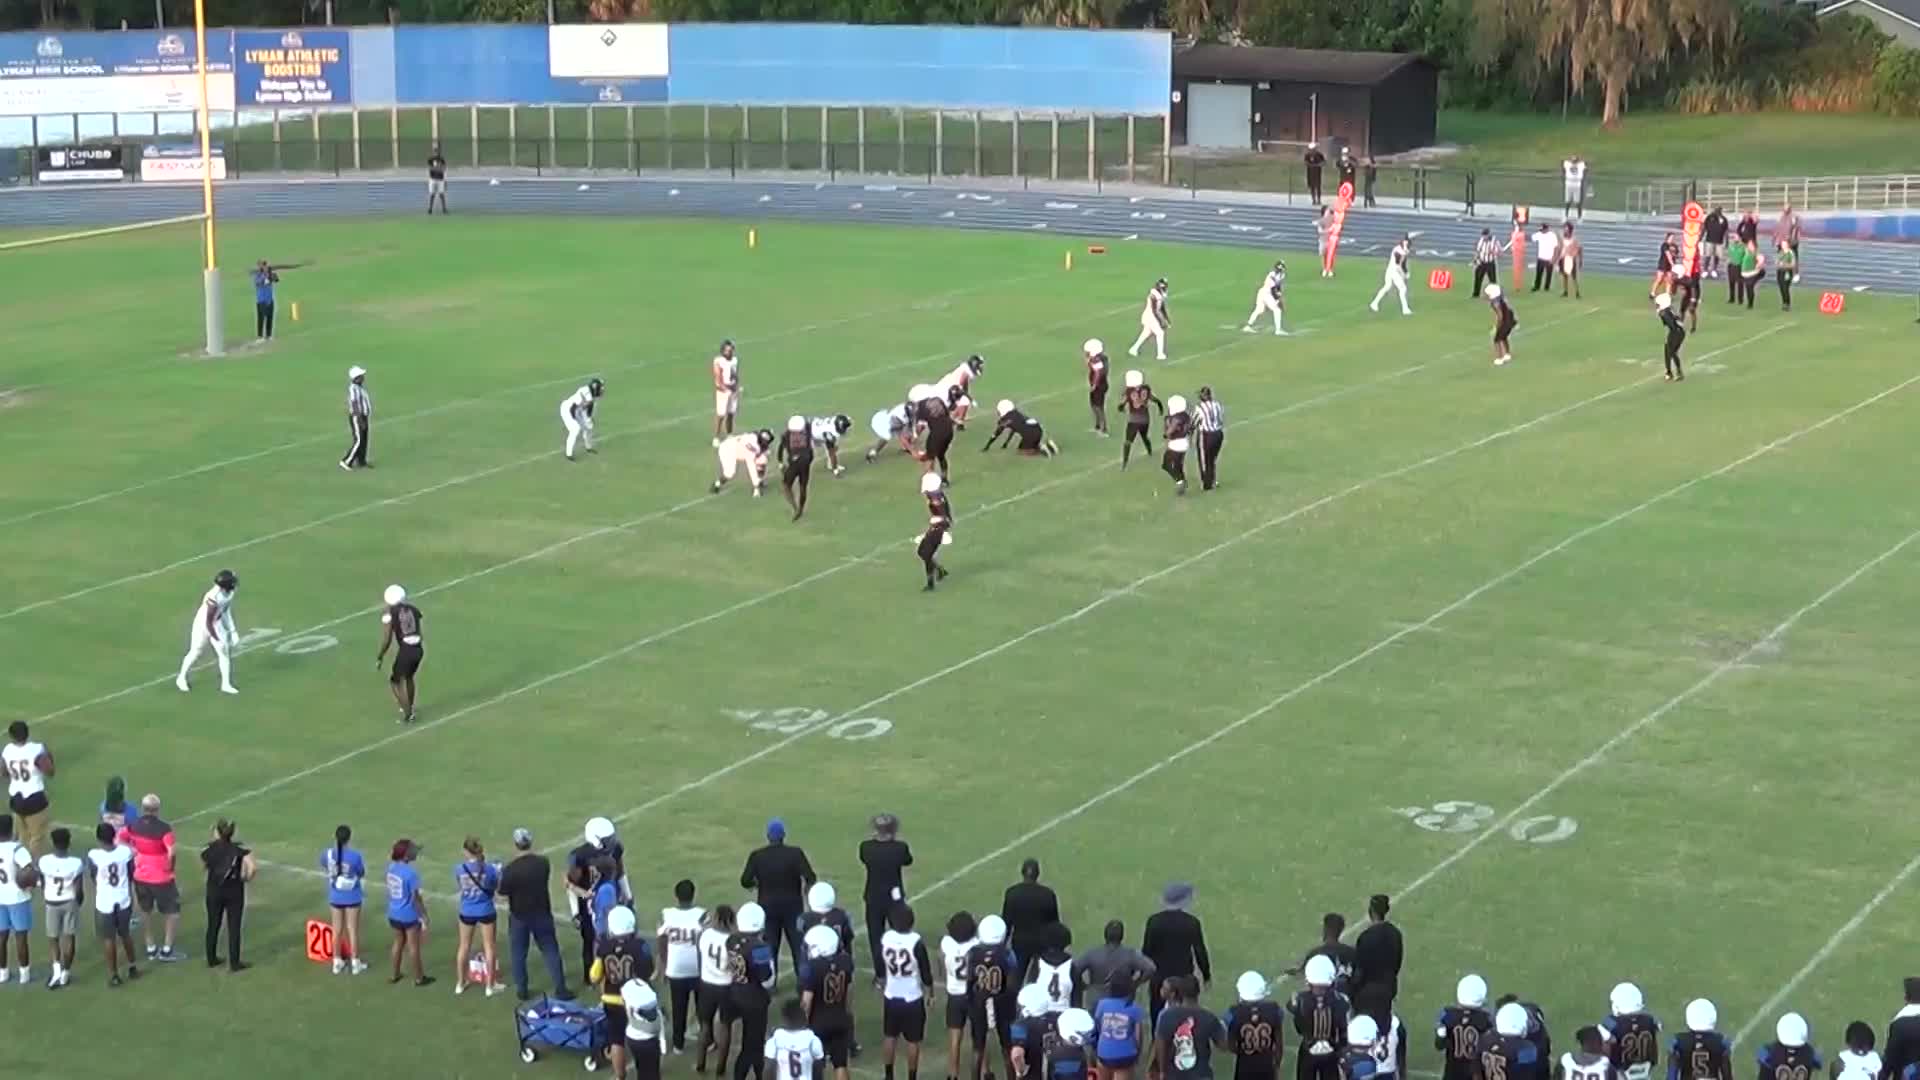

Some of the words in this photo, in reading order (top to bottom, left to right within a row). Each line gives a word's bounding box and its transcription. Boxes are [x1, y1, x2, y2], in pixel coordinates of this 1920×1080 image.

[246, 49, 284, 62] LYMAN
[287, 48, 338, 62] ATHLETIC
[264, 64, 322, 76] BOOSTERS
[1823, 295, 1841, 310] 20
[108, 864, 120, 886] 8
[310, 924, 333, 958] 20
[708, 944, 721, 970] 4
[886, 948, 912, 976] 32
[1048, 973, 1061, 1002] 4
[788, 1050, 802, 1078] 6
[1692, 1052, 1709, 1079] 5
